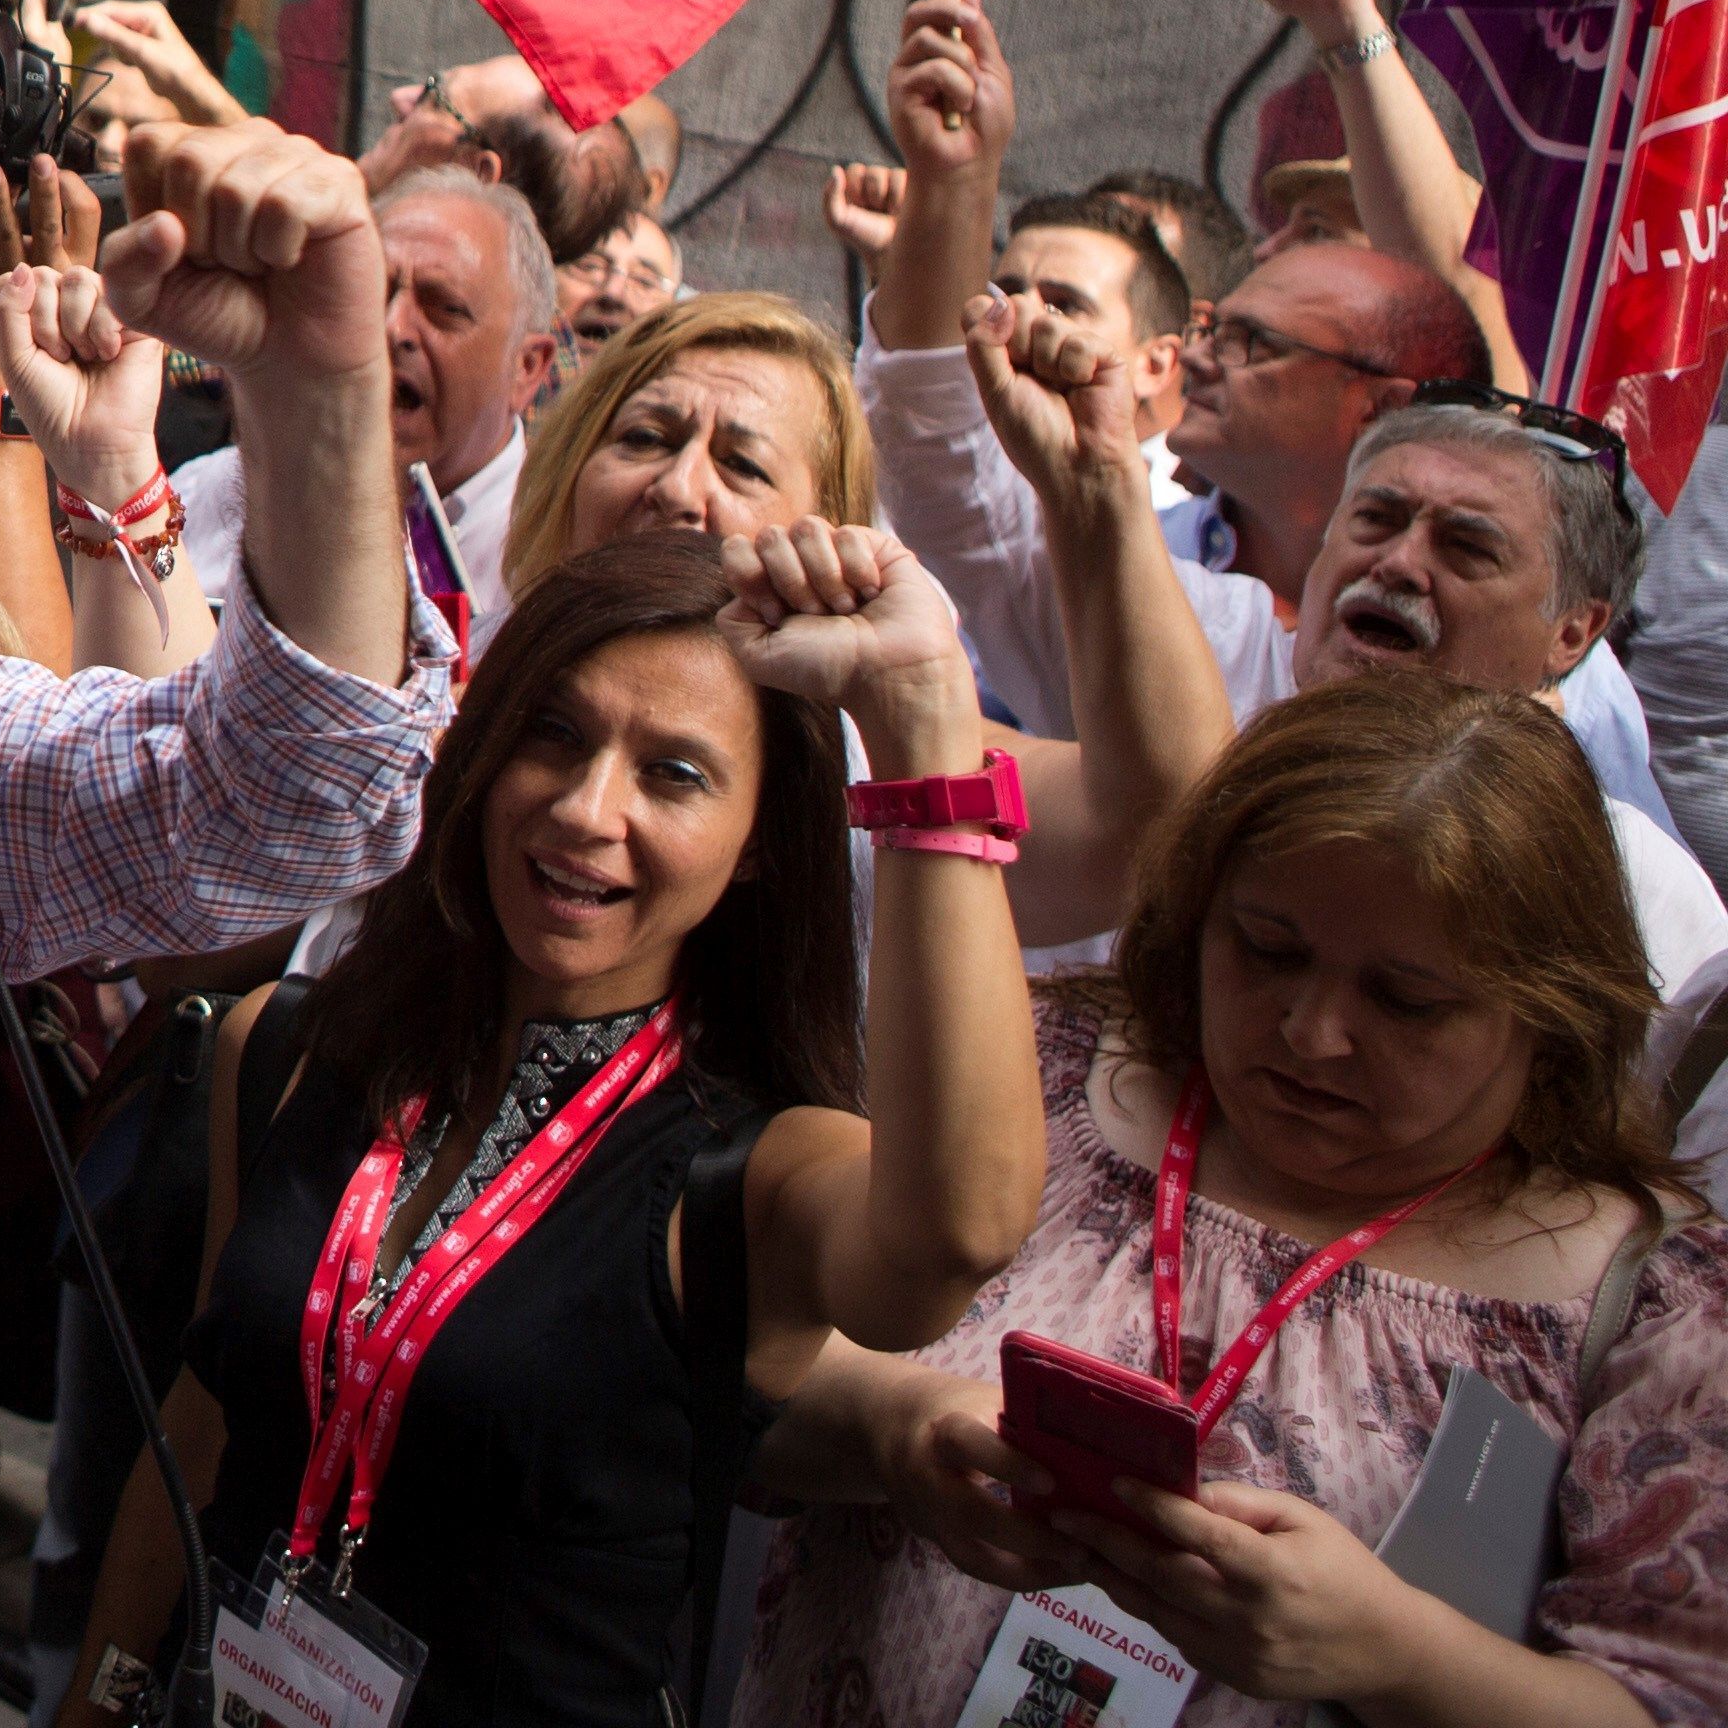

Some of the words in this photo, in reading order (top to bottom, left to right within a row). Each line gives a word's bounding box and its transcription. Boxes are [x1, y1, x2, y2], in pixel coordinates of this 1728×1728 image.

[584, 1049, 641, 1110] www.ugt.es
[478, 1159, 537, 1219] www.ugt.es
[380, 1270, 431, 1339] www.ugt.es
[426, 1257, 482, 1318] www.ugt.es
[1277, 1256, 1335, 1307] www.ugt.es
[320, 1409, 352, 1480] www.ugt.es
[370, 1388, 395, 1462] www.ugt.es
[1021, 1590, 1186, 1684] ORGANIZACIÓN
[217, 1637, 333, 1728] ORGANIZACIÓN
